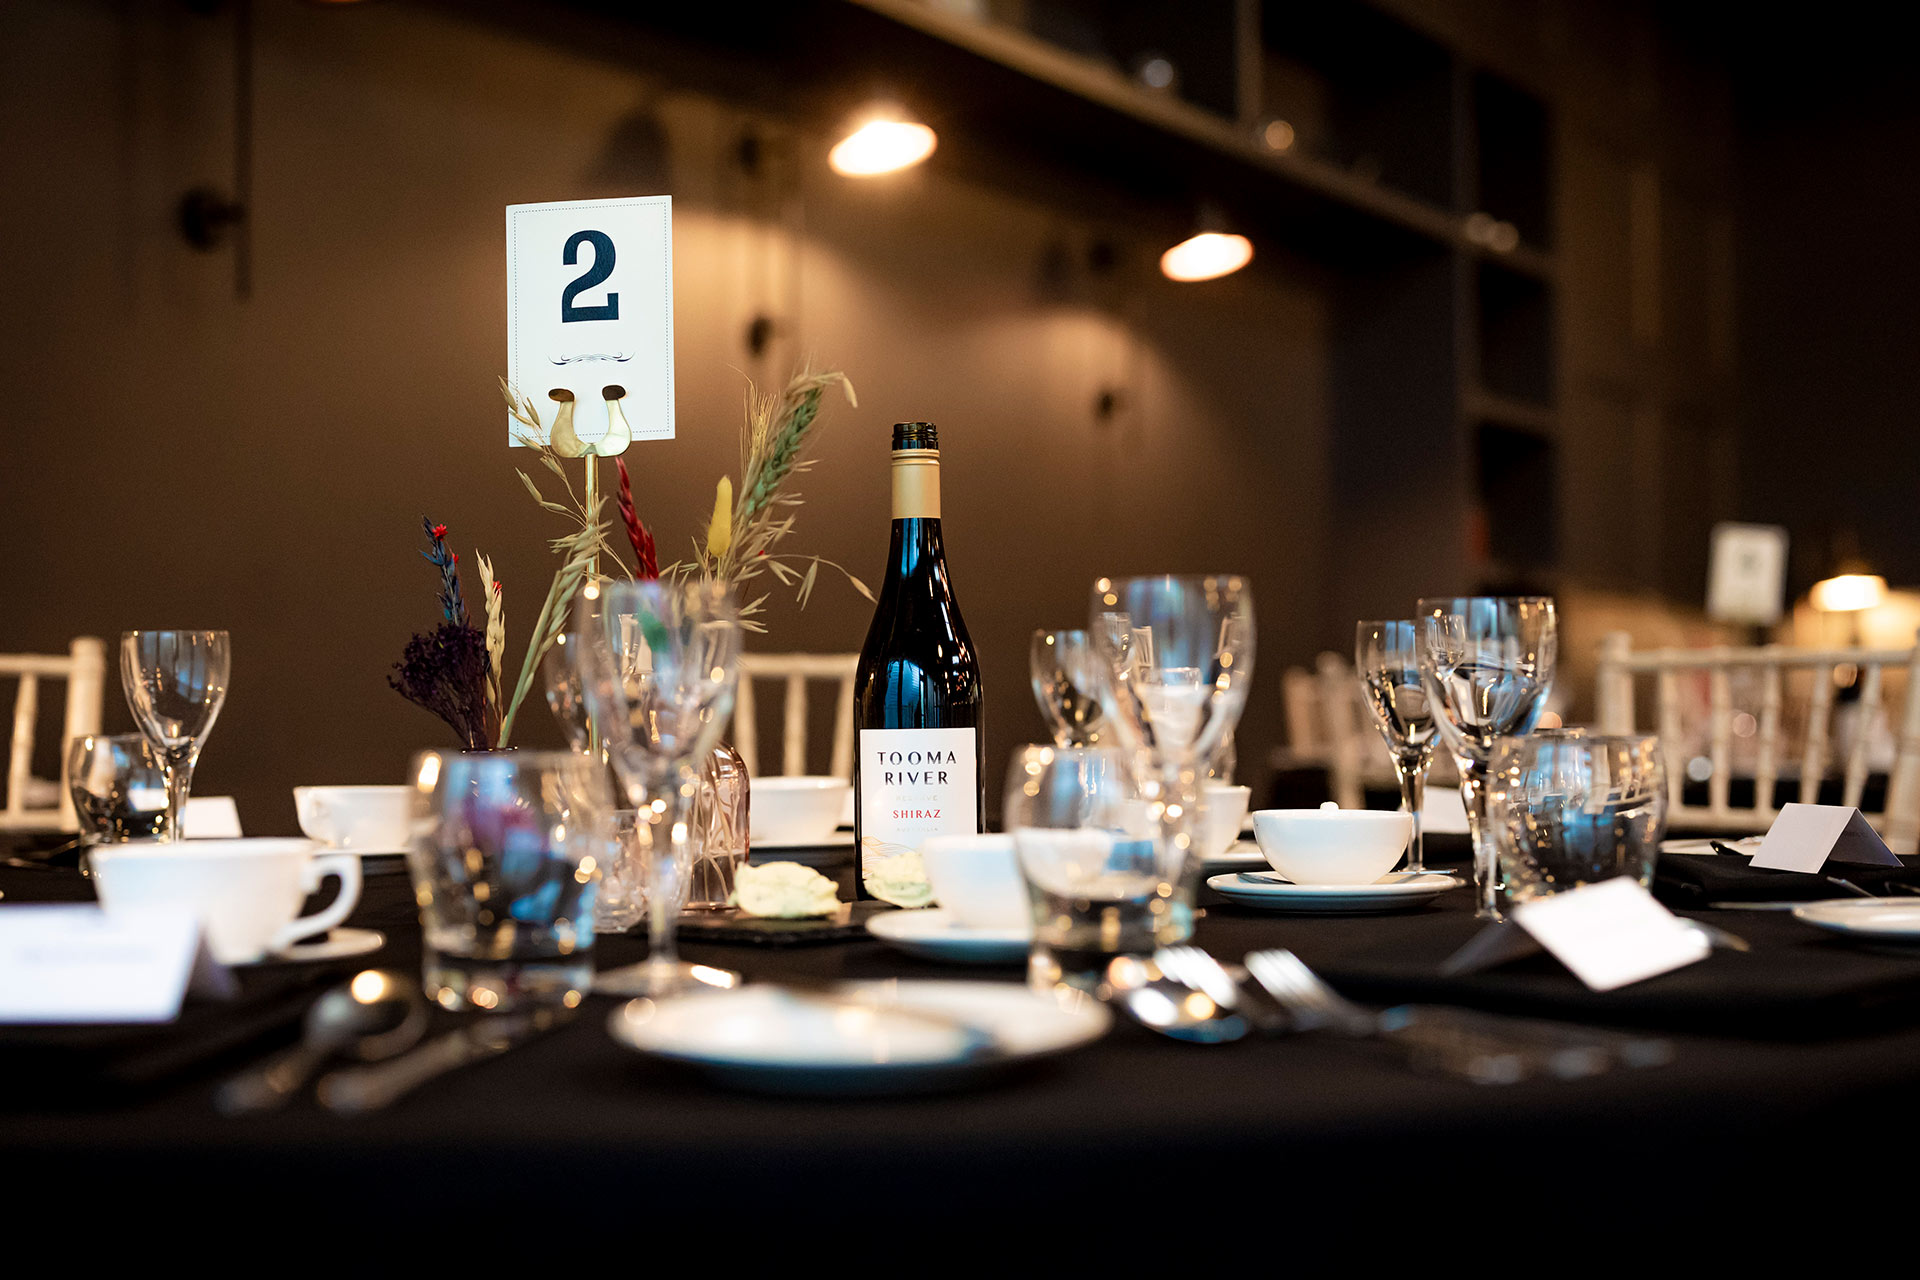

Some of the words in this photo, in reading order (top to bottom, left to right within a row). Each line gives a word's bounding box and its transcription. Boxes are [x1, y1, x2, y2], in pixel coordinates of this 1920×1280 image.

[561, 229, 619, 323] 2
[877, 751, 957, 765] TOOMA
[885, 771, 949, 785] RIVER
[892, 809, 942, 819] SHIRAZ
